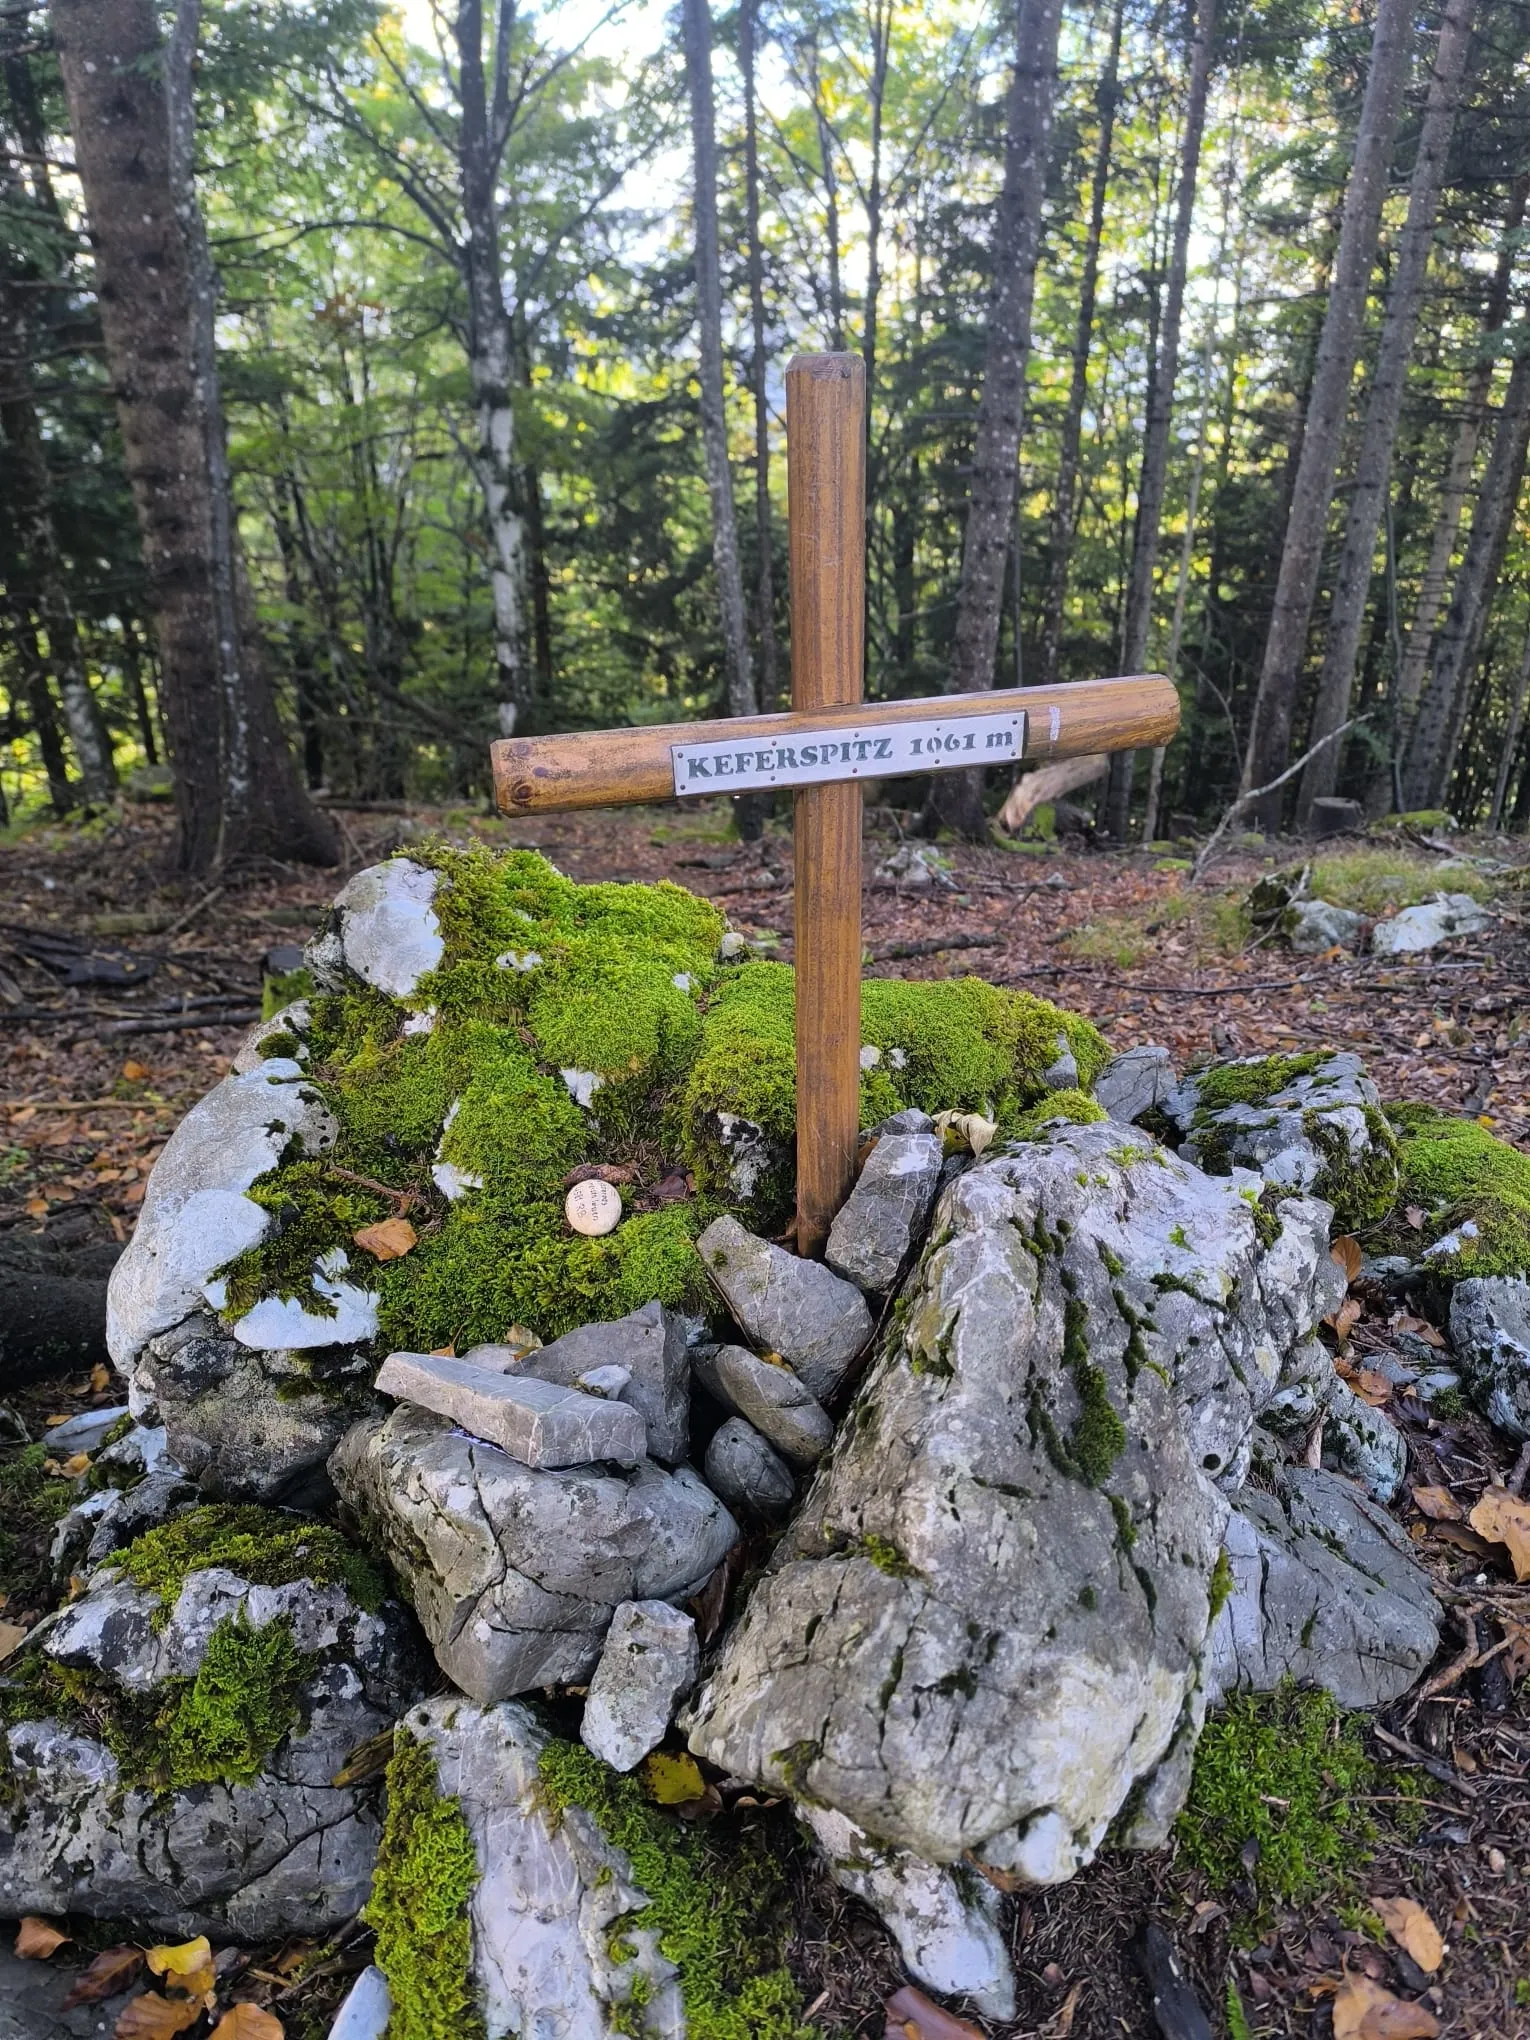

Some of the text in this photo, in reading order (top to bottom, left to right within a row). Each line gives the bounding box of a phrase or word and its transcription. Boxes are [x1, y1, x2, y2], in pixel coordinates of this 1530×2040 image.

[687, 731, 1013, 780] KEFERSPITZ 1061 m
